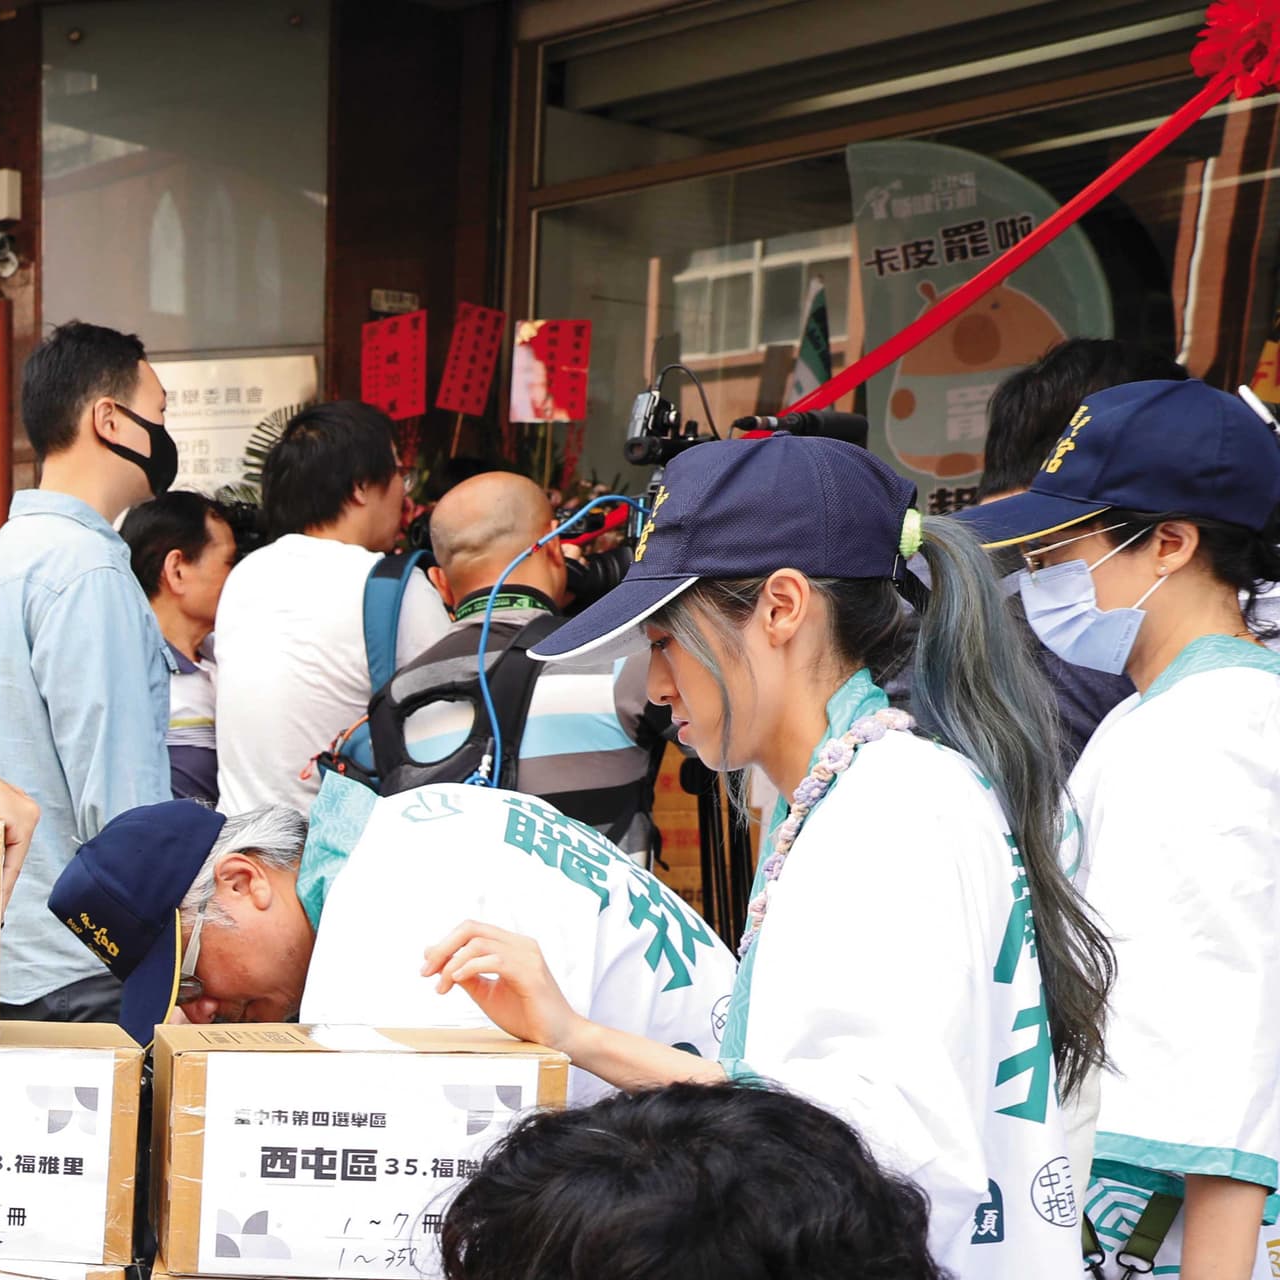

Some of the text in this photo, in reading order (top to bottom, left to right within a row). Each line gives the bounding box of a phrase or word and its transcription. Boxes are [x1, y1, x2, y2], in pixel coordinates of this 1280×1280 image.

[234, 1108, 387, 1129] 臺中市第四選舉區
